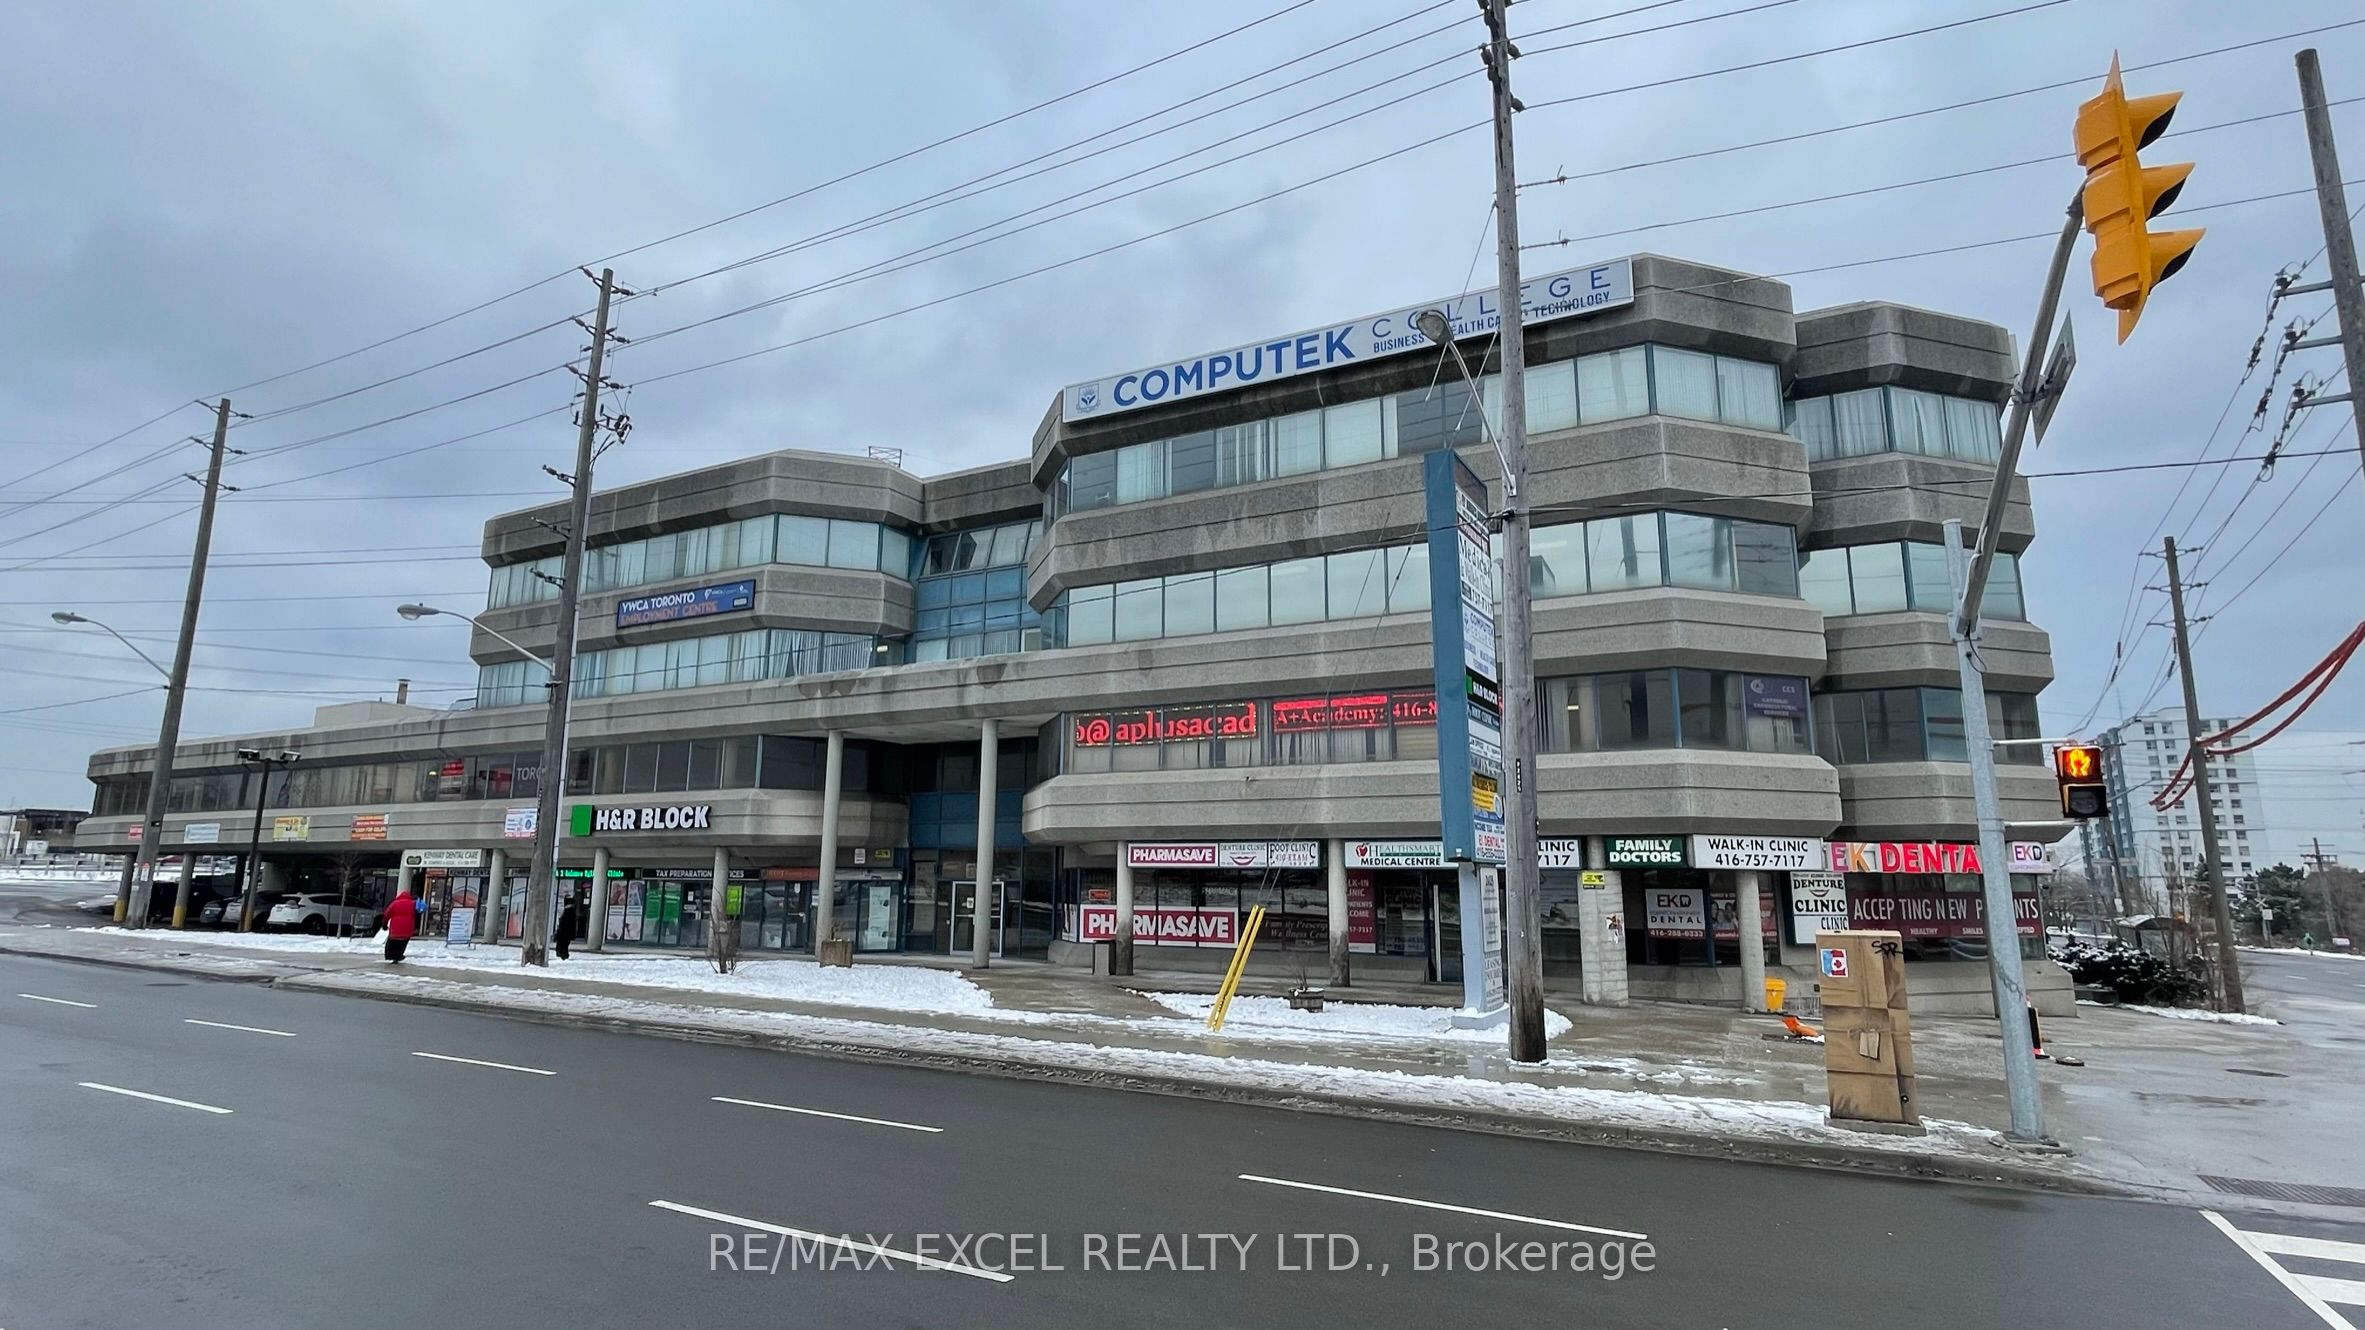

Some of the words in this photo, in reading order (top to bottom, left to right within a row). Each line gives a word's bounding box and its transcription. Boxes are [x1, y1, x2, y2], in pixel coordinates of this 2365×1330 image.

[1373, 333, 1426, 353] BUSINESS
[1452, 317, 1484, 336] EALTH
[1531, 290, 1610, 318] TECHNOLOGY
[1113, 326, 1356, 407] COMPUTEK
[622, 600, 649, 613] YWCA
[651, 591, 695, 609] TORONTO
[620, 608, 678, 625] EMPLOYMENT
[682, 600, 718, 616] CENTRE
[595, 808, 636, 831] H&R
[640, 805, 710, 830] BLOCK
[1369, 845, 1440, 856] HEALTHSMART
[1615, 839, 1673, 851] FAMILY
[1708, 838, 1765, 851] WALK-IN
[1769, 840, 1808, 852] CLINIC
[1133, 849, 1213, 862] PHARMASAVE
[1609, 851, 1682, 863] DOCTORS
[1879, 842, 1983, 874] DENTA
[2014, 845, 2043, 861] EKD
[1361, 858, 1401, 866] MEDICAL
[1404, 858, 1441, 866] CENTRE
[1715, 854, 1805, 867] 416-757-7117
[656, 869, 669, 877] TAX
[669, 869, 713, 878] PREPARATION
[1793, 879, 1844, 890] DENTURE
[1657, 894, 1692, 908] EKD
[1795, 899, 1846, 912] CLINIC
[1650, 915, 1703, 924] DENTAL
[1820, 916, 1848, 930] CLINIC
[1910, 927, 1939, 935] HEALTHY
[1962, 927, 1984, 935] SMILES
